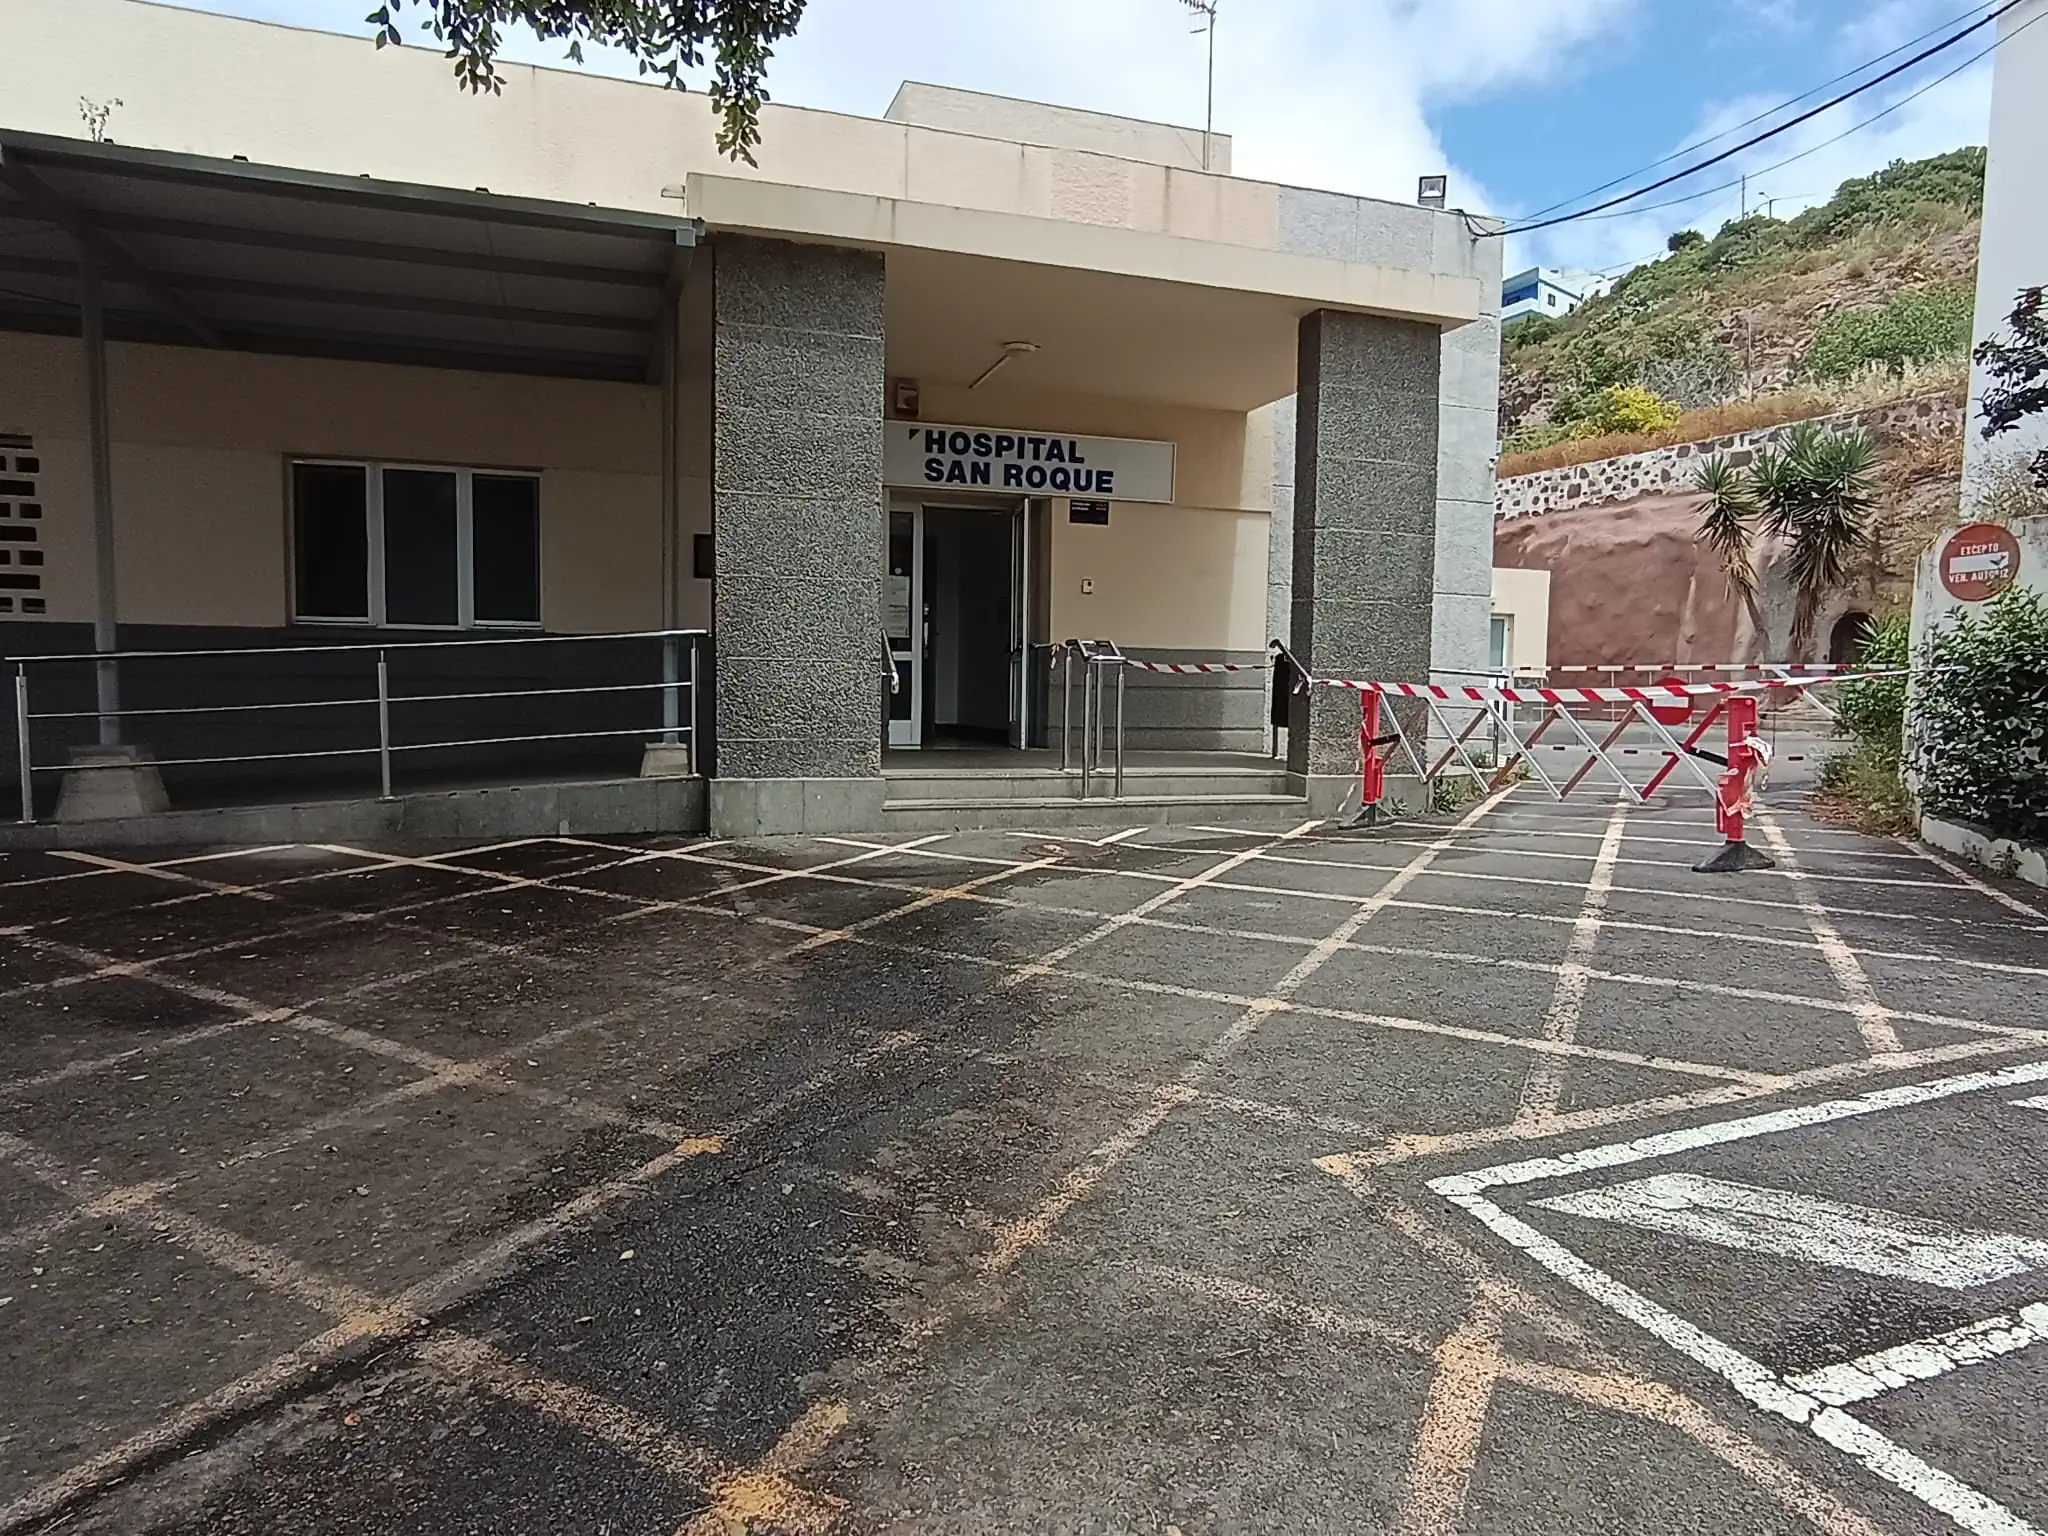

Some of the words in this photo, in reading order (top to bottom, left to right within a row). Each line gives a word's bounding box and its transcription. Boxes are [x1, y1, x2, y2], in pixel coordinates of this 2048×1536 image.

[925, 430, 1085, 463] HOSPITAL
[924, 458, 991, 485] SAN
[1003, 464, 1114, 493] ROQUE
[1960, 543, 1999, 556] EXCEPTO
